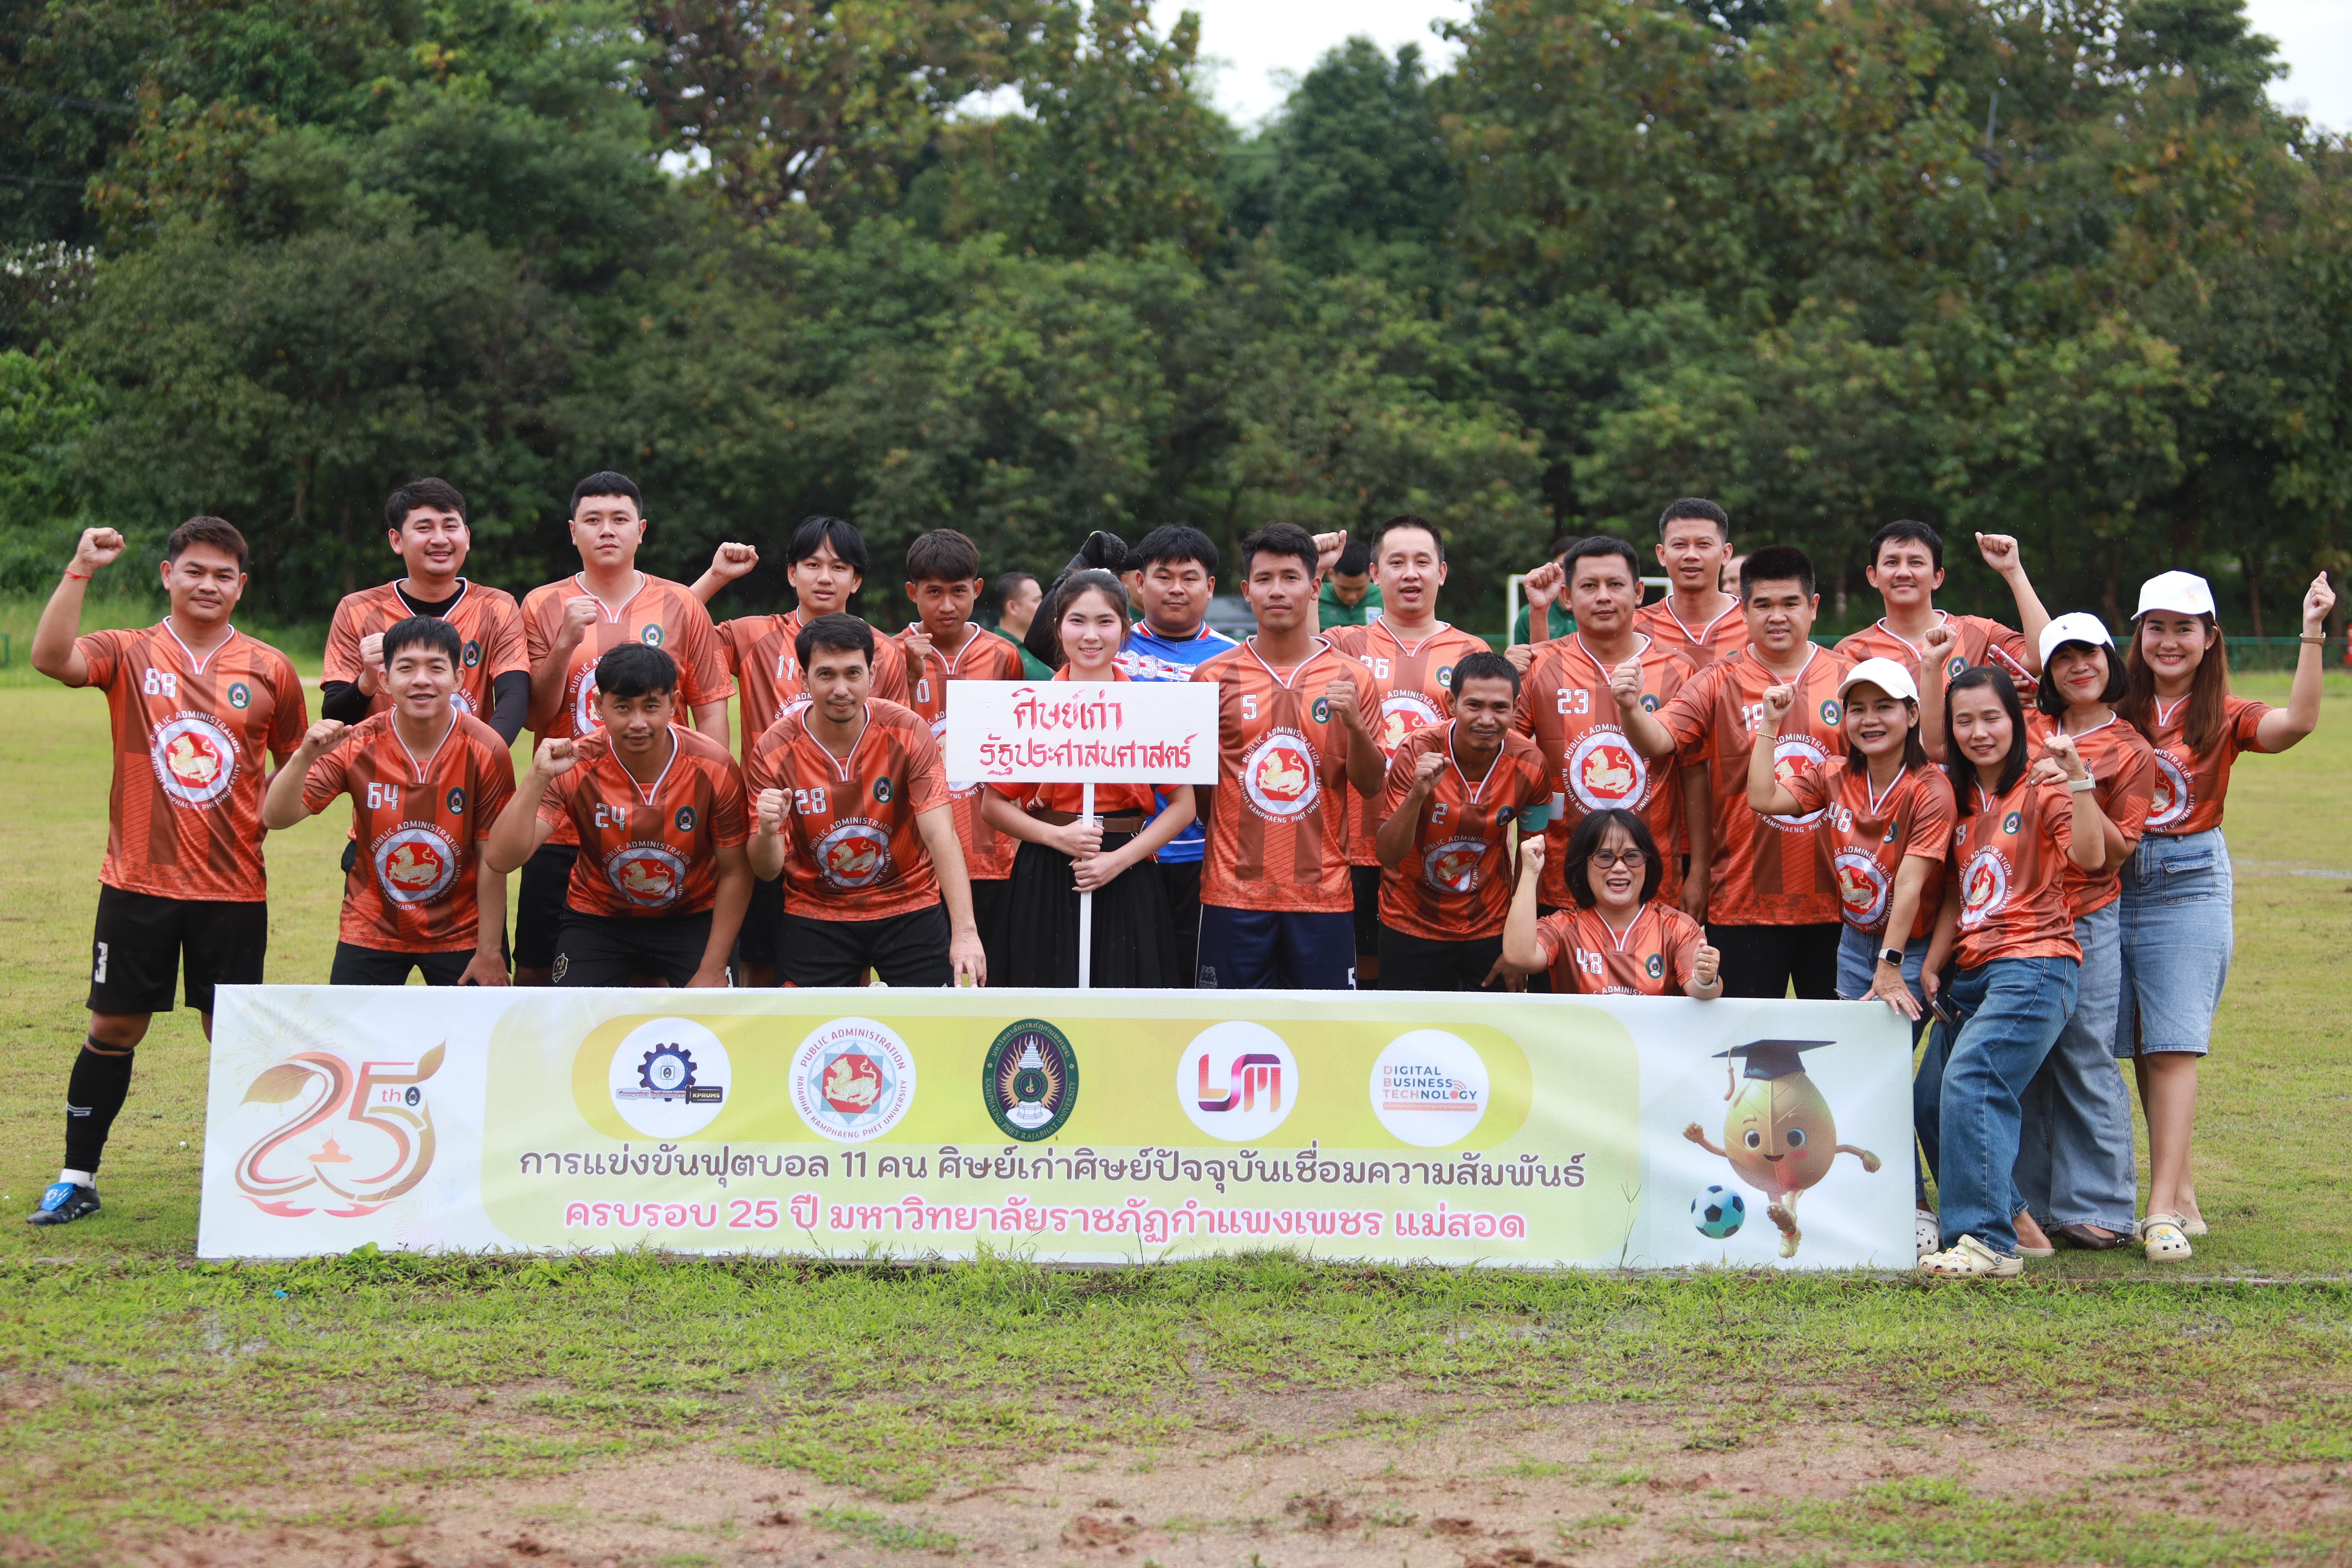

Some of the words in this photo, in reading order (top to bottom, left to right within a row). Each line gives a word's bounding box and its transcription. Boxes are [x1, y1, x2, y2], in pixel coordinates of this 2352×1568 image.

[776, 655, 795, 680] 11
[1124, 649, 1158, 678] 33
[144, 667, 177, 698] 88
[569, 663, 591, 694] PUBLIC
[1011, 687, 1125, 732] ศิษย์เก่า
[1242, 694, 1257, 720] 5
[1387, 689, 1447, 721] ADMINISTRATIO
[1557, 688, 1589, 714] 23
[150, 715, 173, 742] PUBLIC
[176, 710, 241, 753] ADMINISTRATION
[1564, 731, 1587, 760] PUBLIC
[980, 732, 1199, 776] รัฐประศาสนศาสตร์
[1242, 735, 1265, 763] PUBLIC
[367, 781, 400, 810] 64
[795, 787, 827, 815] 28
[965, 786, 978, 798] PHET
[1637, 773, 1652, 811] UNIVERSITY
[595, 802, 626, 831] 24
[1248, 803, 1287, 824] KAMPHAENG
[1291, 811, 1306, 823] PHET
[1431, 802, 1448, 825] 2
[1762, 815, 1805, 833] KAMPHAENG
[1808, 820, 1823, 831] PHET
[1828, 801, 1853, 833] 48
[2170, 794, 2195, 828] UNIVERSITY
[370, 827, 395, 852] PUBLIC
[397, 821, 462, 856] ADMINISTRATION
[810, 829, 828, 851] PUBLIC
[830, 817, 893, 835] ADMINISTRATION
[1423, 839, 1446, 853] PUBLIC
[602, 845, 624, 864] PUBLIC
[626, 840, 692, 865] ADMINISTRATION
[383, 889, 416, 911] KAMPHAENG
[420, 897, 437, 907] PHET
[439, 864, 462, 898] UNIVERSITY
[1878, 892, 1894, 925] UNIVERSITY
[1576, 947, 1603, 975] 48
[800, 1036, 828, 1067] PUBLIC
[831, 1028, 905, 1070] ADMINISTRATION
[1383, 1065, 1441, 1075] DIGITAL
[1383, 1078, 1453, 1087] BUSINESS
[381, 1088, 401, 1102] th
[797, 1076, 813, 1115] RAJABHAT
[810, 1115, 859, 1138] KAMPHAENG
[862, 1123, 883, 1136] PHET
[884, 1080, 907, 1124] UNIVERSITY
[1383, 1089, 1477, 1099] TECHNOLOGY
[235, 1037, 447, 1202] 25
[985, 1078, 1004, 1123] KAMPHAENG
[1003, 1122, 1018, 1136] PHET
[1021, 1122, 1058, 1141] RAJABHAT
[1058, 1081, 1076, 1123] UNIVERSITY
[520, 1144, 829, 1188] การแข่งขันฟุตบอล
[842, 1151, 866, 1178] 11
[878, 1156, 927, 1178] คน
[939, 1140, 1586, 1193] ศิษย์เก่าศิษย์ปัจจุบันเชื่อมความสัมพันธ์
[566, 1201, 717, 1227] ครบรอบ
[729, 1199, 778, 1228] 25
[791, 1194, 818, 1229] ปี
[830, 1195, 1384, 1243] มหาวิทยาลัยราชภัฏกำแพงเพชร
[1395, 1202, 1525, 1239] แม่สอด
